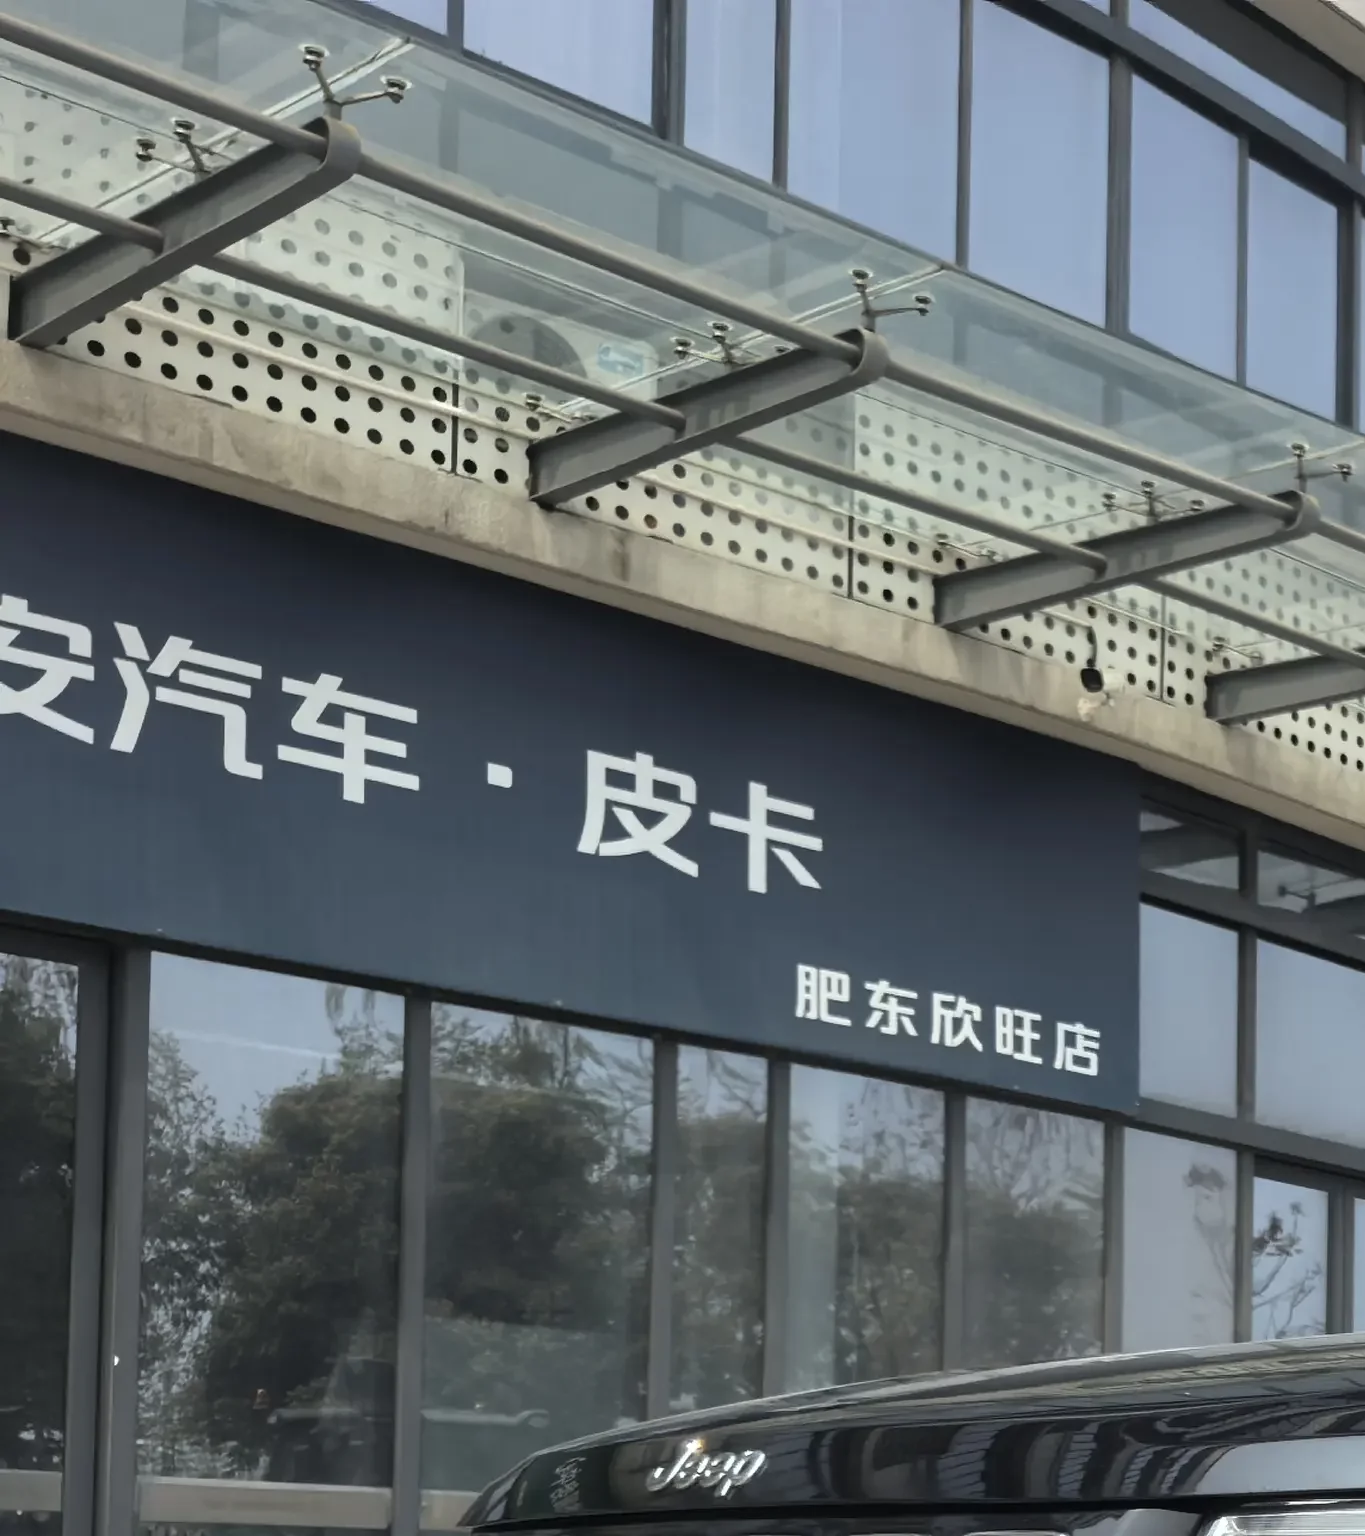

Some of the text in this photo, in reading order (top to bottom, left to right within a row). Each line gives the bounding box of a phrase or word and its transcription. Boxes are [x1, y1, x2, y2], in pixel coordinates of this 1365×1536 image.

[794, 963, 1100, 1077] 肥东欣旺店
[646, 1439, 767, 1500] Jeep
